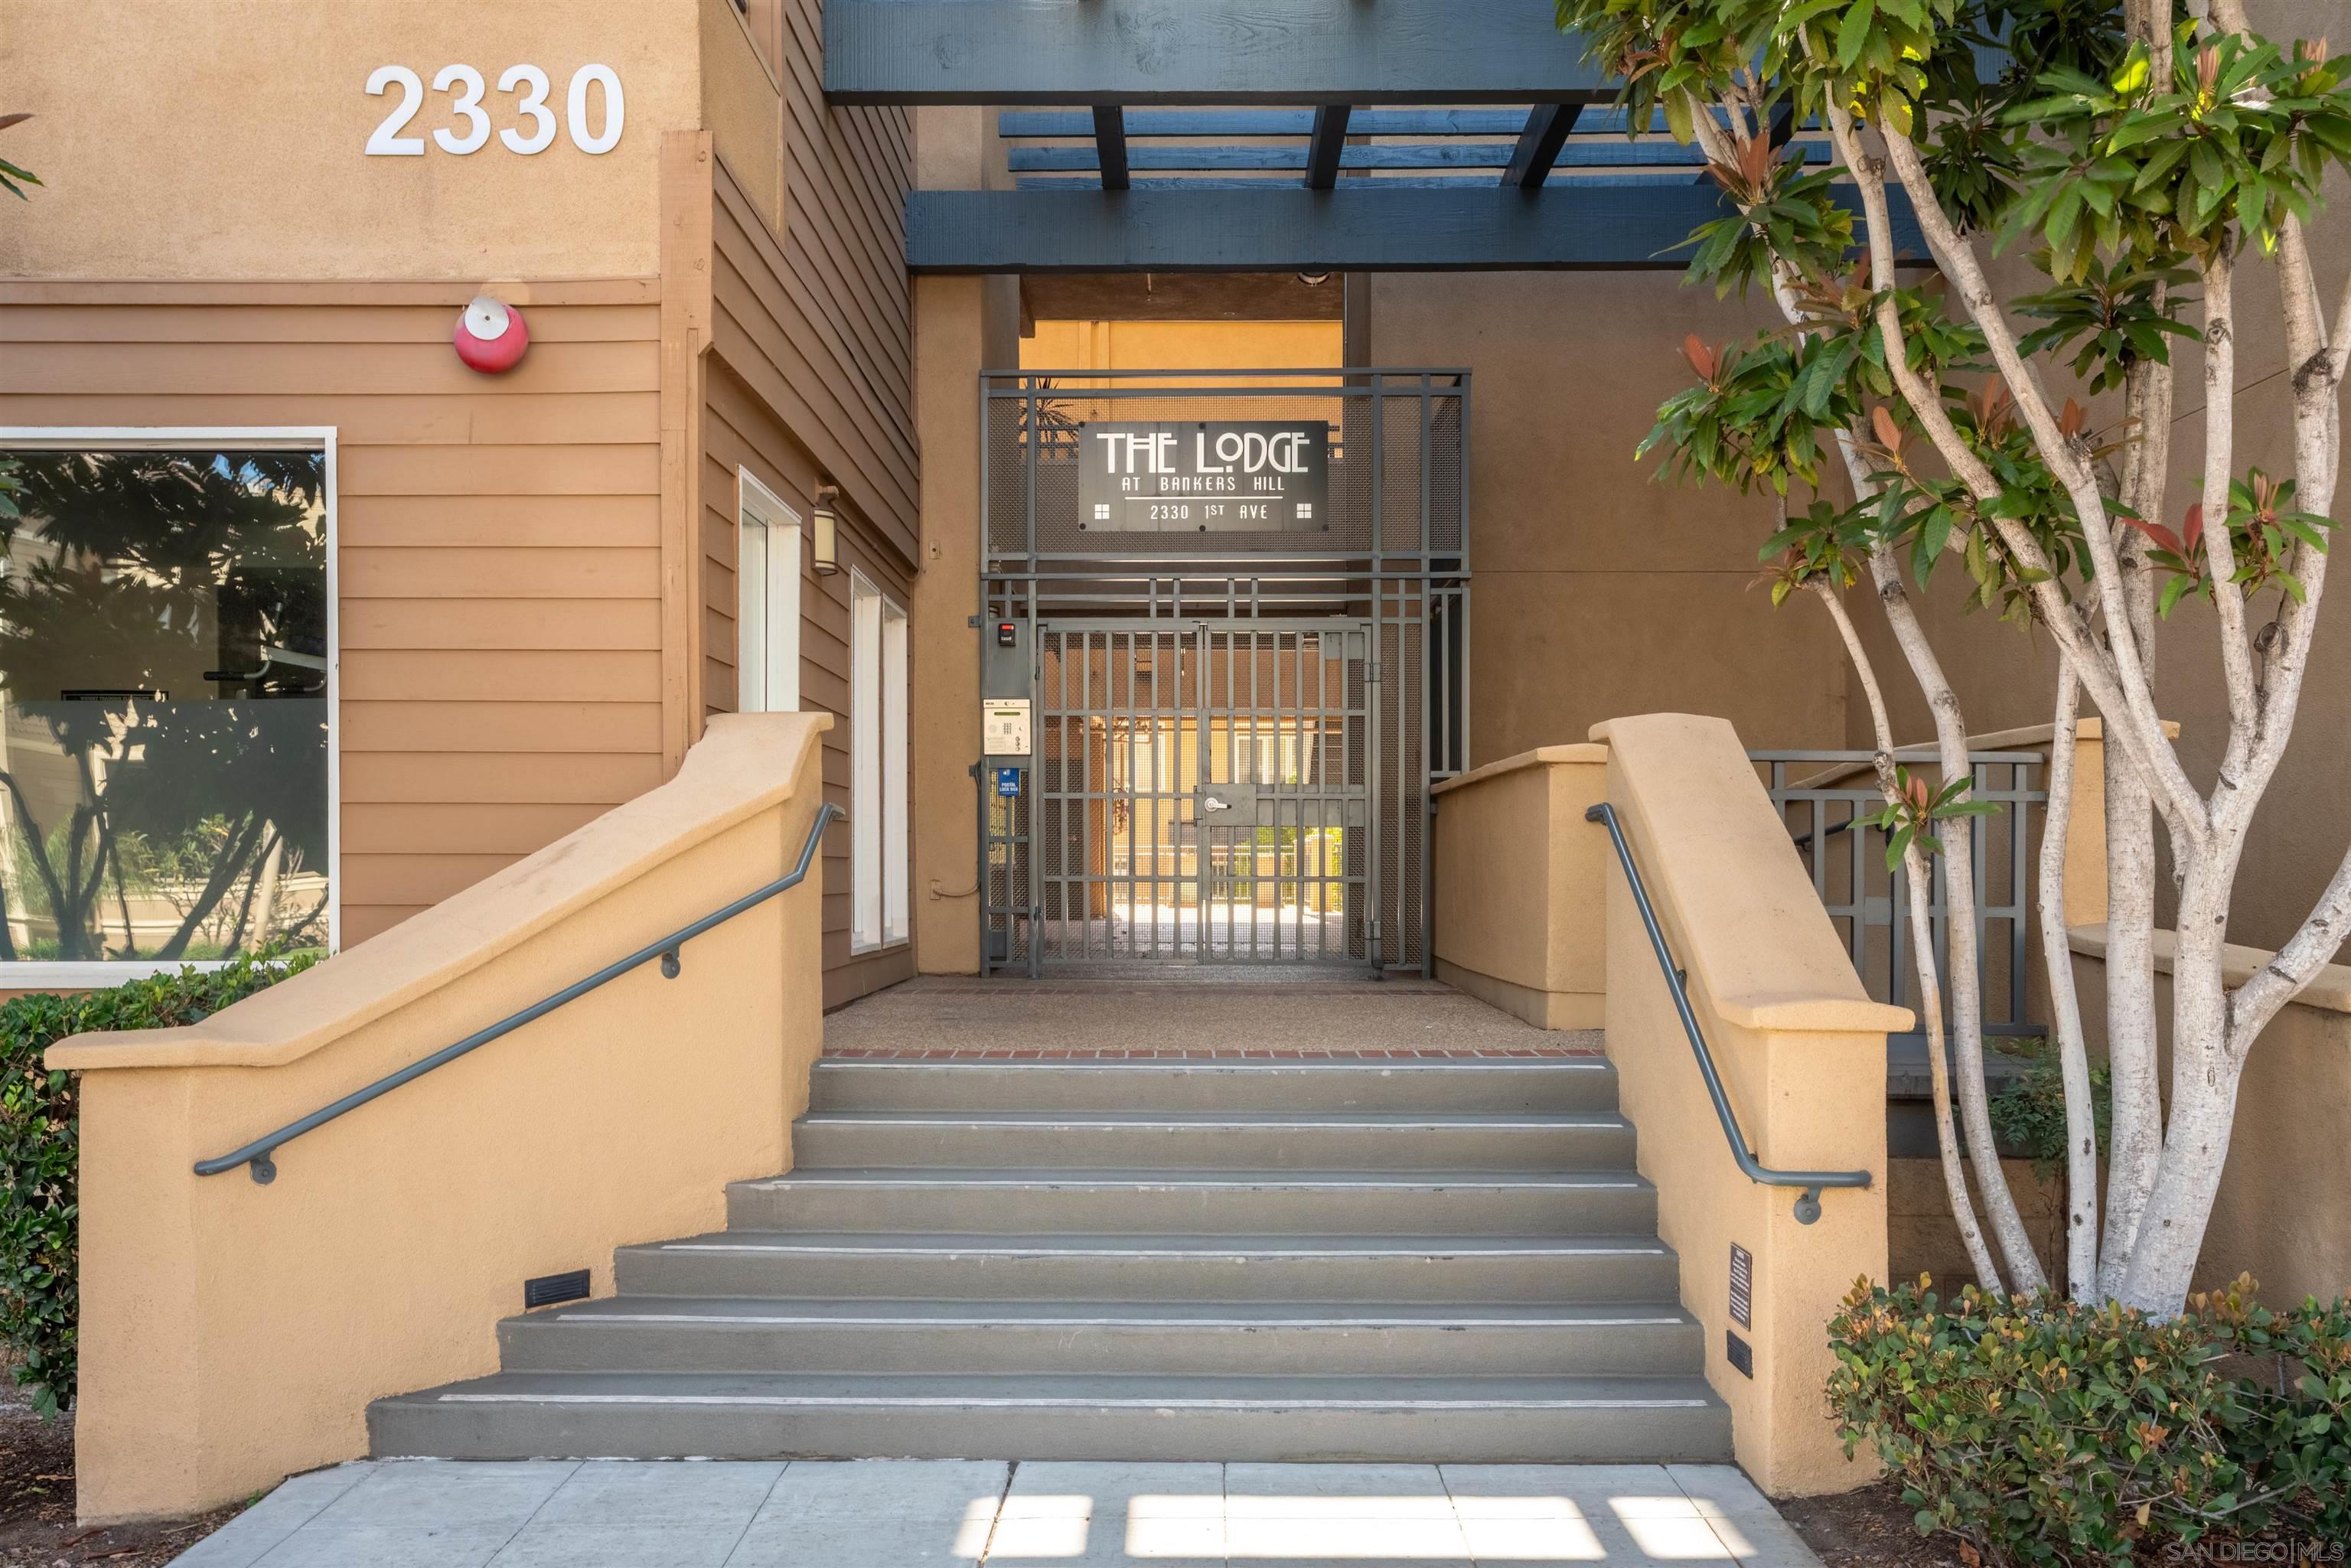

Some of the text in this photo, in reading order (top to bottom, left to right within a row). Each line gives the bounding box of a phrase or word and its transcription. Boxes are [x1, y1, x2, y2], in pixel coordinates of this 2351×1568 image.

[364, 64, 624, 155] 2330
[1096, 432, 1310, 474] THE LODGE
[1122, 475, 1285, 491] AT BANKERS HILL
[1150, 504, 1268, 520] 2330 1ST AVE
